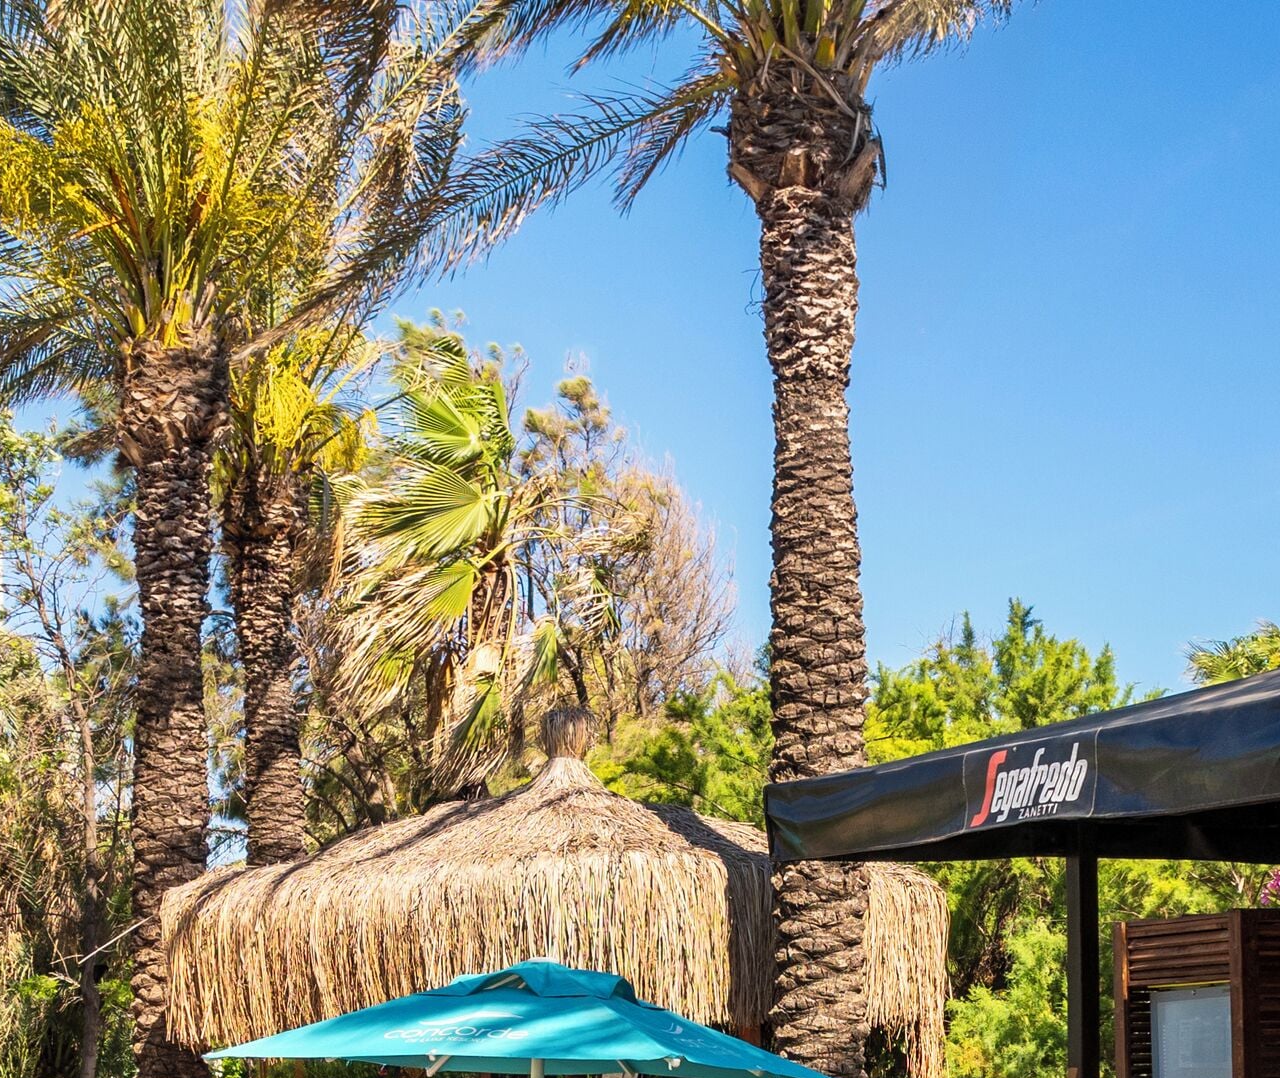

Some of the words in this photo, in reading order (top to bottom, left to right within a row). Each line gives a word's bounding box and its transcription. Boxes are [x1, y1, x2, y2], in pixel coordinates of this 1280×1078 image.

[970, 742, 1088, 828] Segafredo
[1019, 803, 1058, 820] ZANETTI
[384, 1026, 529, 1040] concorde
